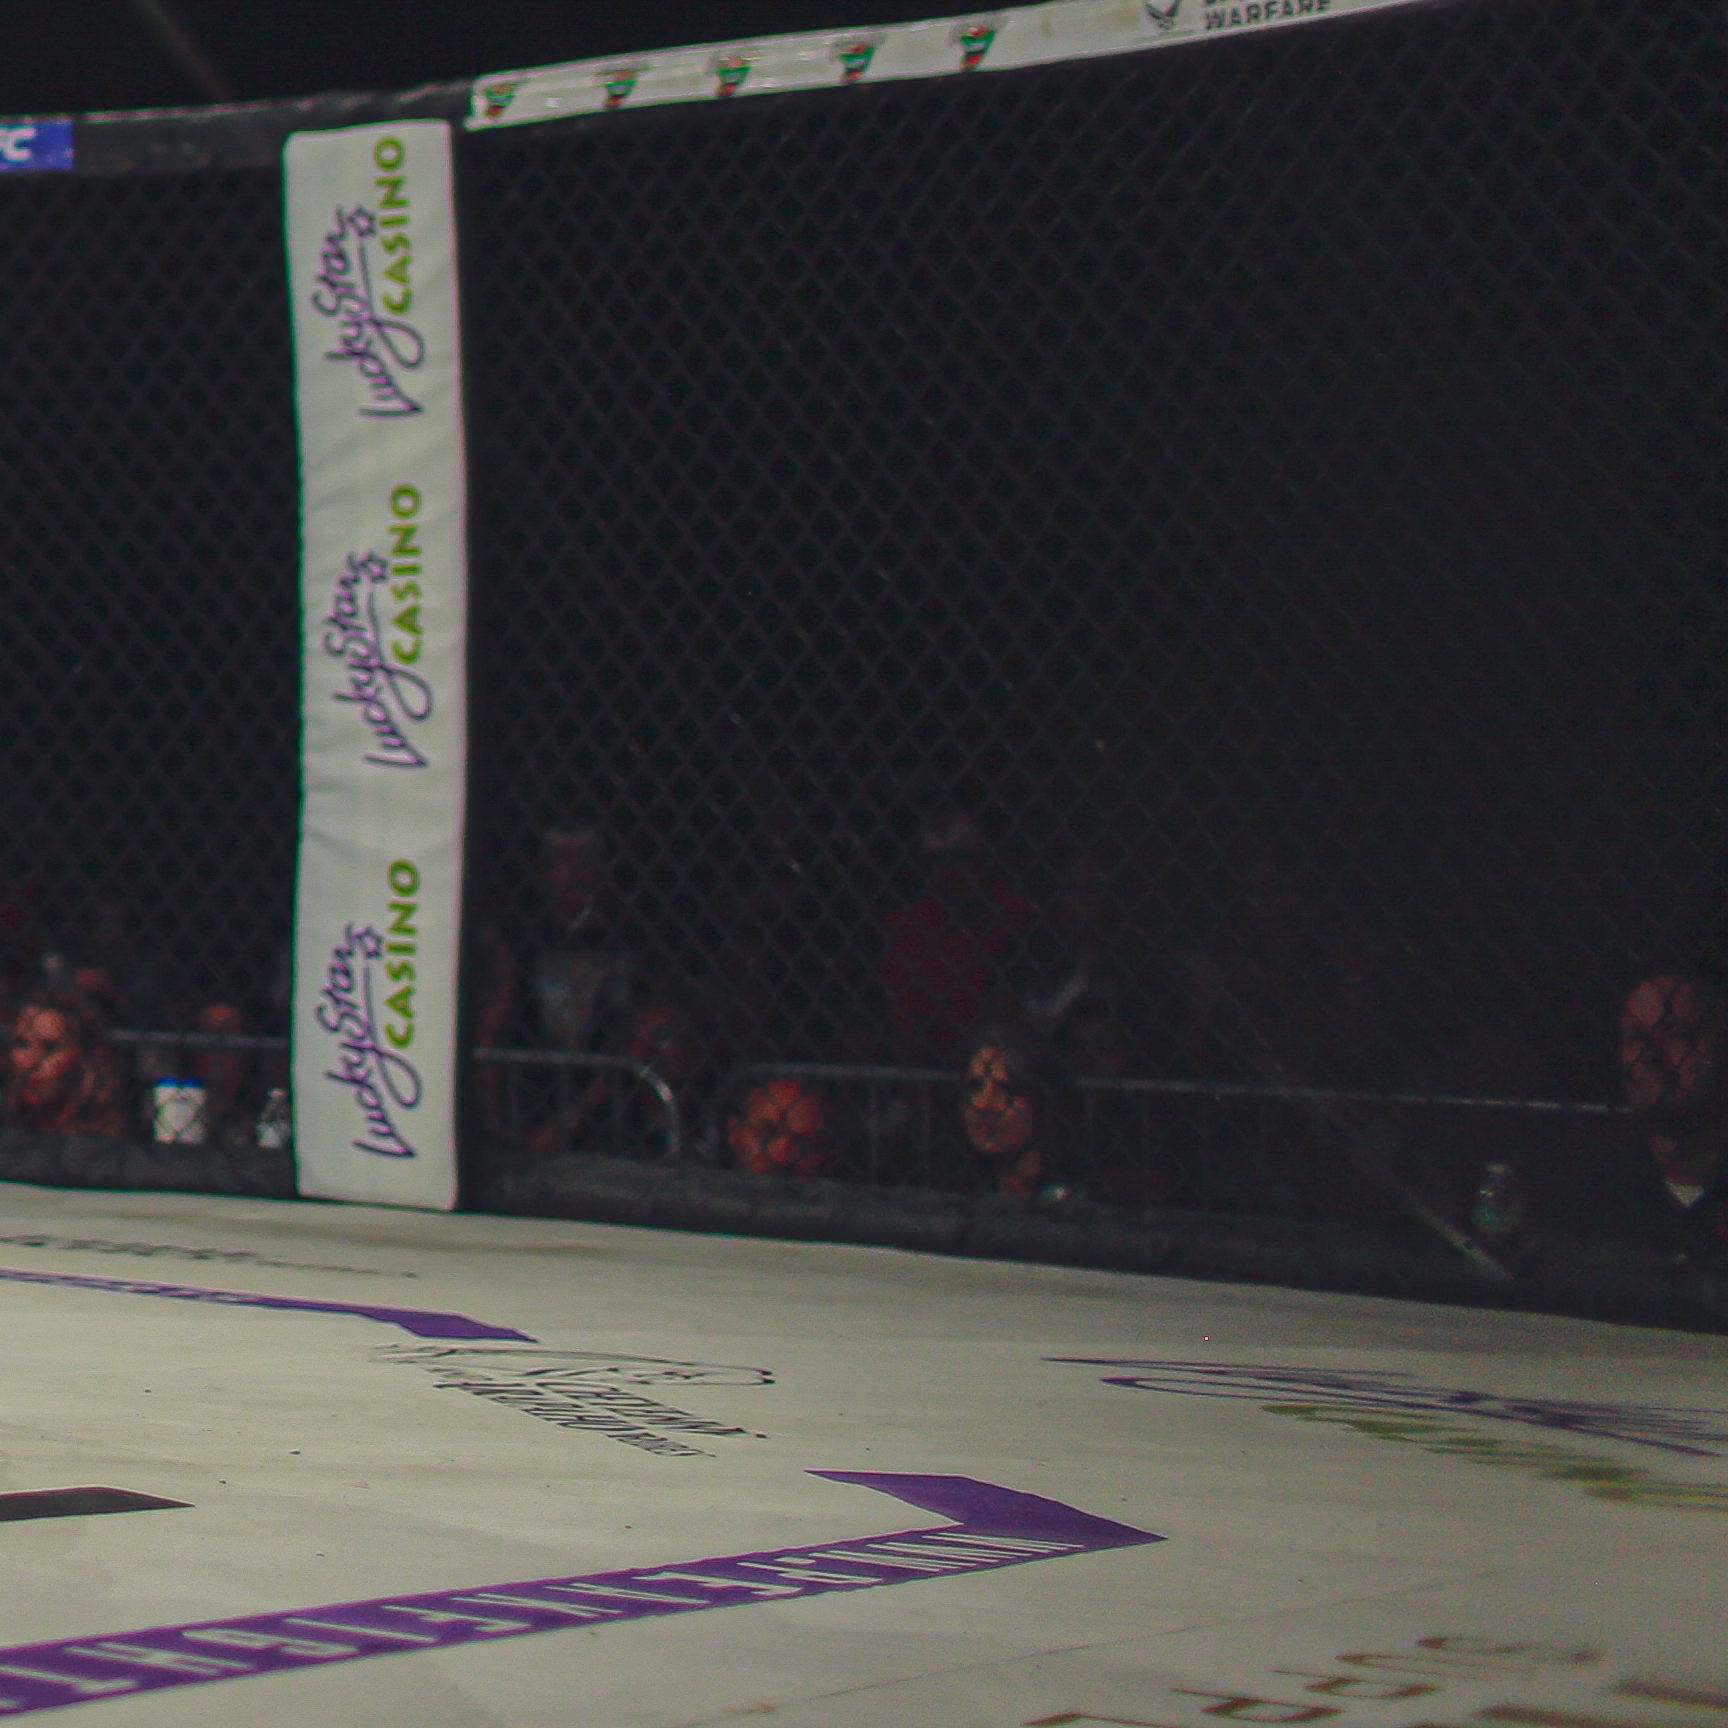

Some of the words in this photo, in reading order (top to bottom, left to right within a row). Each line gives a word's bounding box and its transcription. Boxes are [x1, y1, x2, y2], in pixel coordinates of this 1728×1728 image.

[374, 135, 413, 315] CASINO
[389, 484, 423, 665] CASINO
[385, 859, 421, 1049] CASINO
